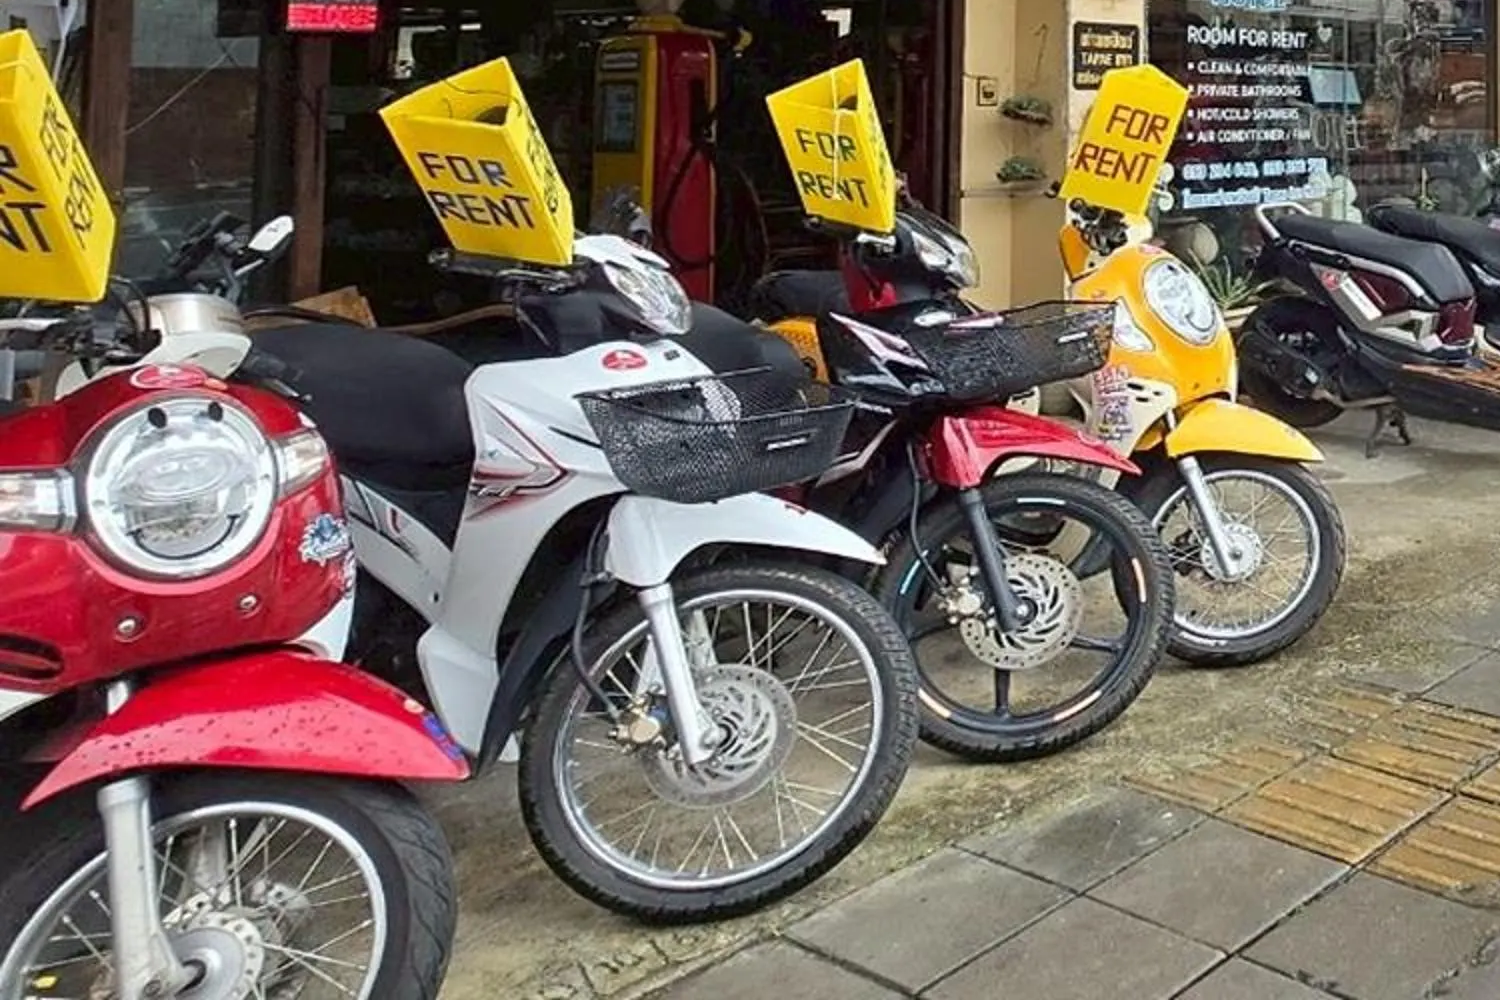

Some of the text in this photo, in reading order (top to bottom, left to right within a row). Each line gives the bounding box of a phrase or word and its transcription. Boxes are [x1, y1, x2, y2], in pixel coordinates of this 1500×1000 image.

[1187, 24, 1308, 49] ROOM FOR RENT
[1197, 60, 1234, 74] CLEAN
[1197, 84, 1240, 97] PRIVATE
[1106, 103, 1170, 145] FOR
[1197, 129, 1215, 143] AIR
[795, 127, 858, 163] FOR
[1074, 141, 1158, 185] RENT
[416, 151, 513, 189] FOR
[798, 170, 869, 208] RENT
[427, 190, 535, 229] RENT
